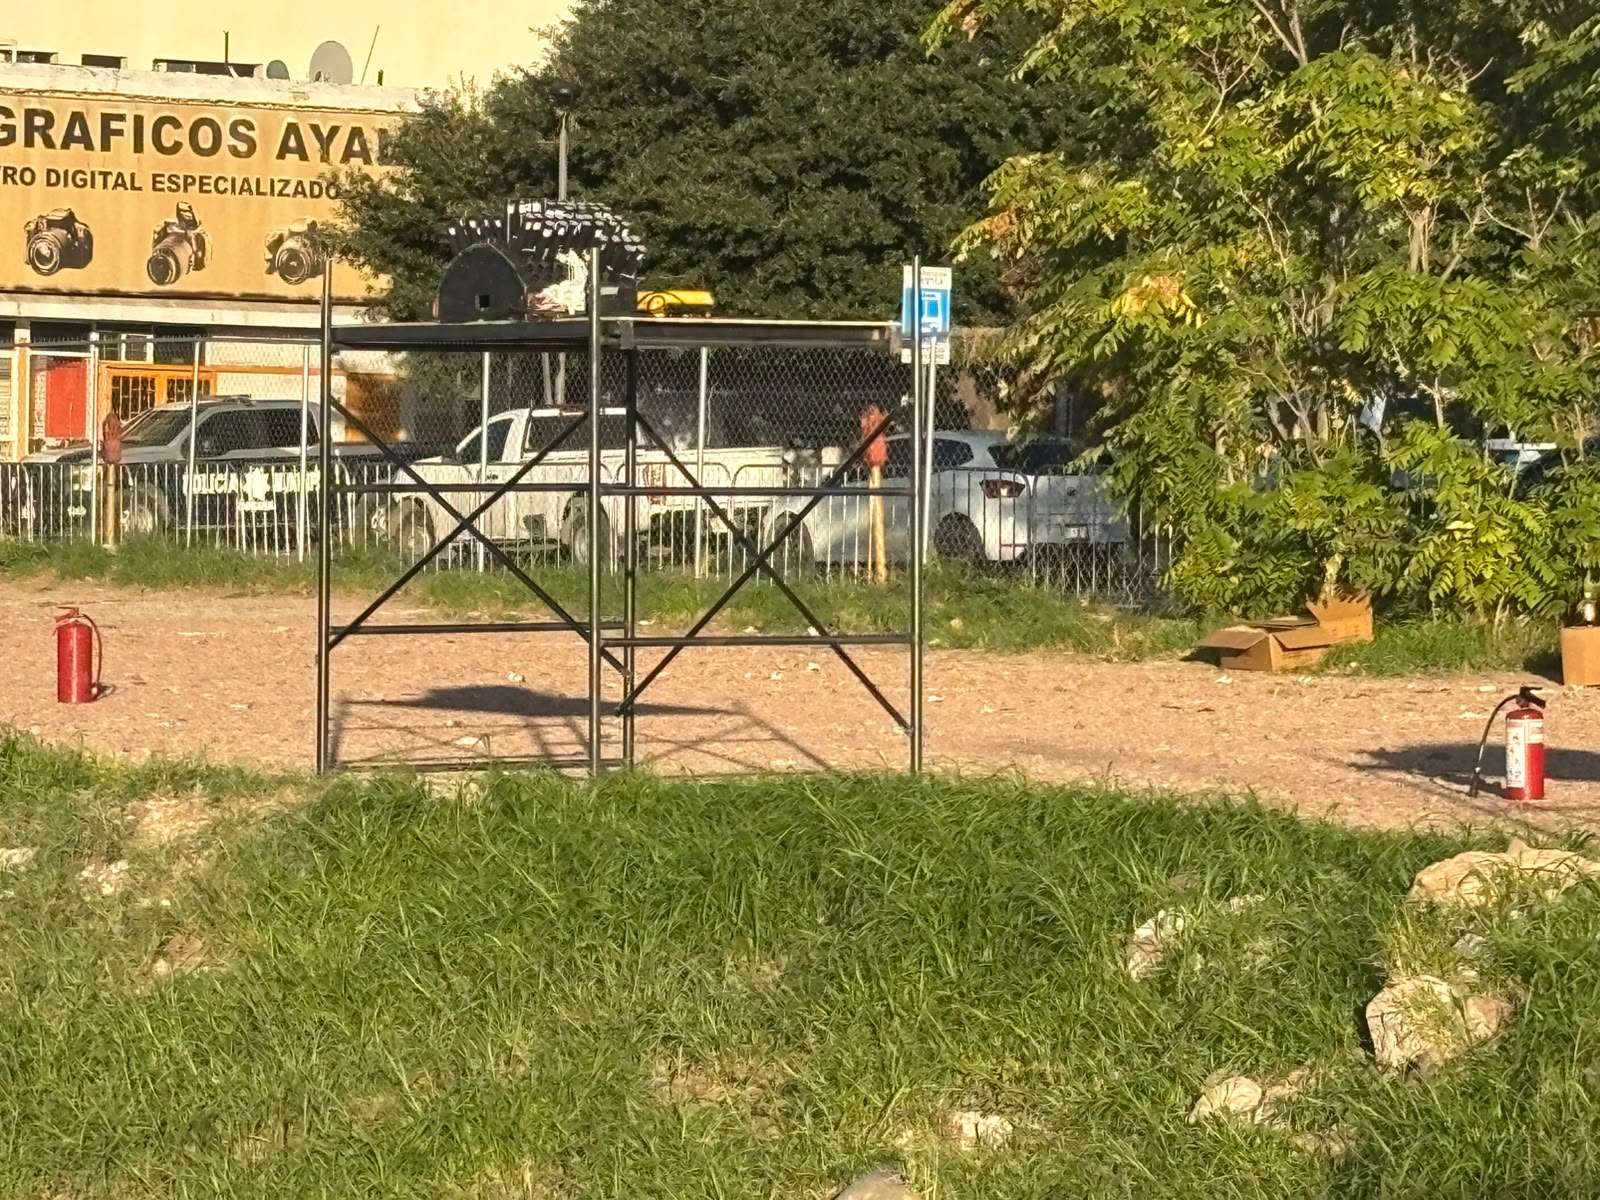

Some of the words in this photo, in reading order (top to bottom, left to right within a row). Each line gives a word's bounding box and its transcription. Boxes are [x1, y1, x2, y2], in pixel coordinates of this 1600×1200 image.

[0, 165, 36, 186] RO
[46, 168, 143, 192] DIGITAL
[152, 173, 341, 200] ESPECIALIZADO
